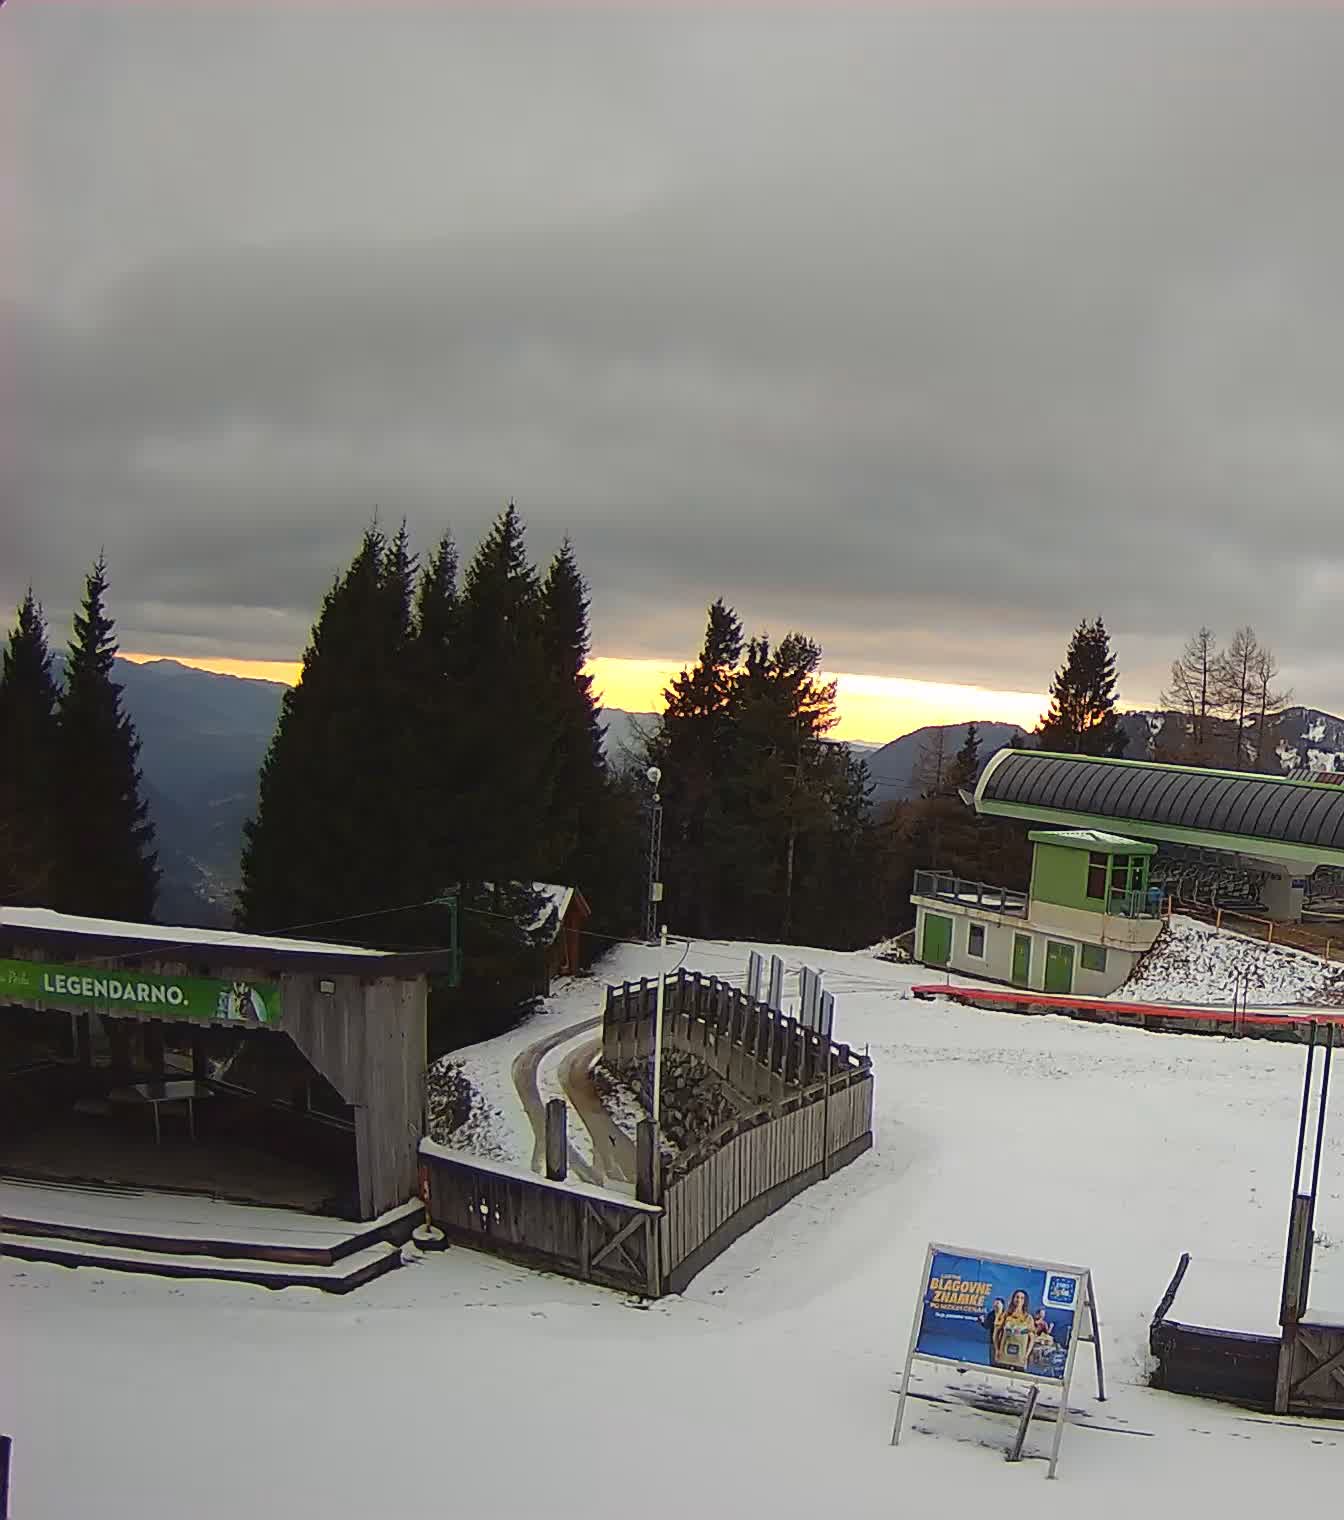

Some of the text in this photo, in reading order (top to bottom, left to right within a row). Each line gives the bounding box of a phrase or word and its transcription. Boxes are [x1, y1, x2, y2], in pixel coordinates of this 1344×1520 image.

[43, 973, 190, 1006] LEGENDARNO.
[930, 1277, 992, 1296] BLAGOVNE
[932, 1290, 985, 1307] ZNAMKE
